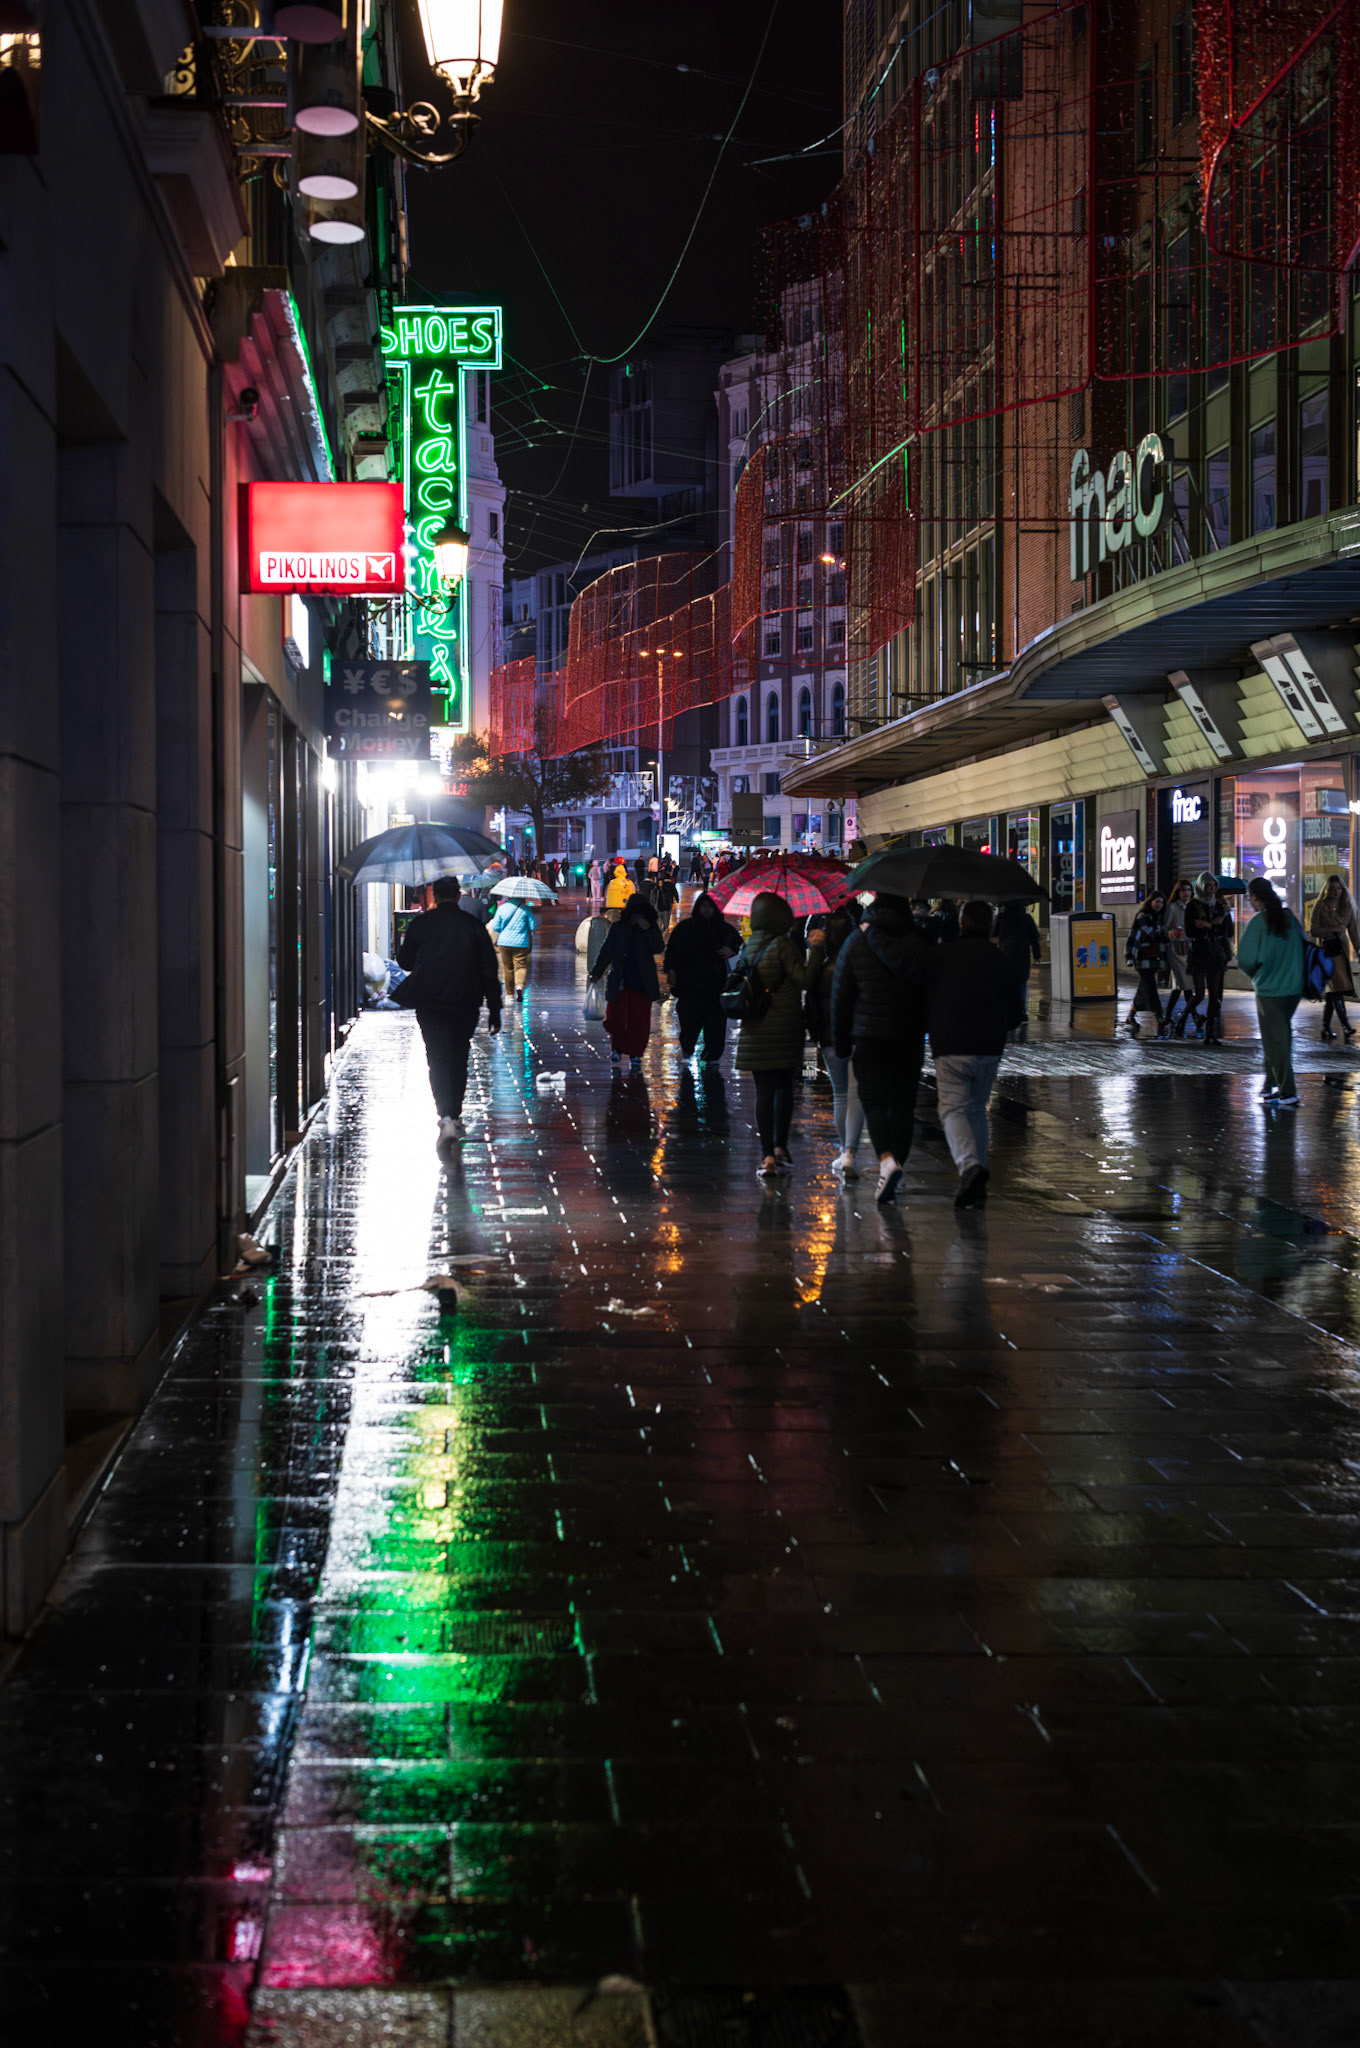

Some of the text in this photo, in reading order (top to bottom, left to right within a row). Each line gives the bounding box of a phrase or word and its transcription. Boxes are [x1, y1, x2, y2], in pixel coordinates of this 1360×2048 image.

[381, 316, 493, 354] SHOES
[1068, 432, 1165, 582] fnac
[266, 556, 360, 580] PIKOLINOS
[334, 708, 427, 732] Change
[340, 733, 422, 756] Money
[1172, 789, 1202, 823] fnac
[1100, 825, 1136, 873] fnac
[1262, 816, 1287, 902] nac
